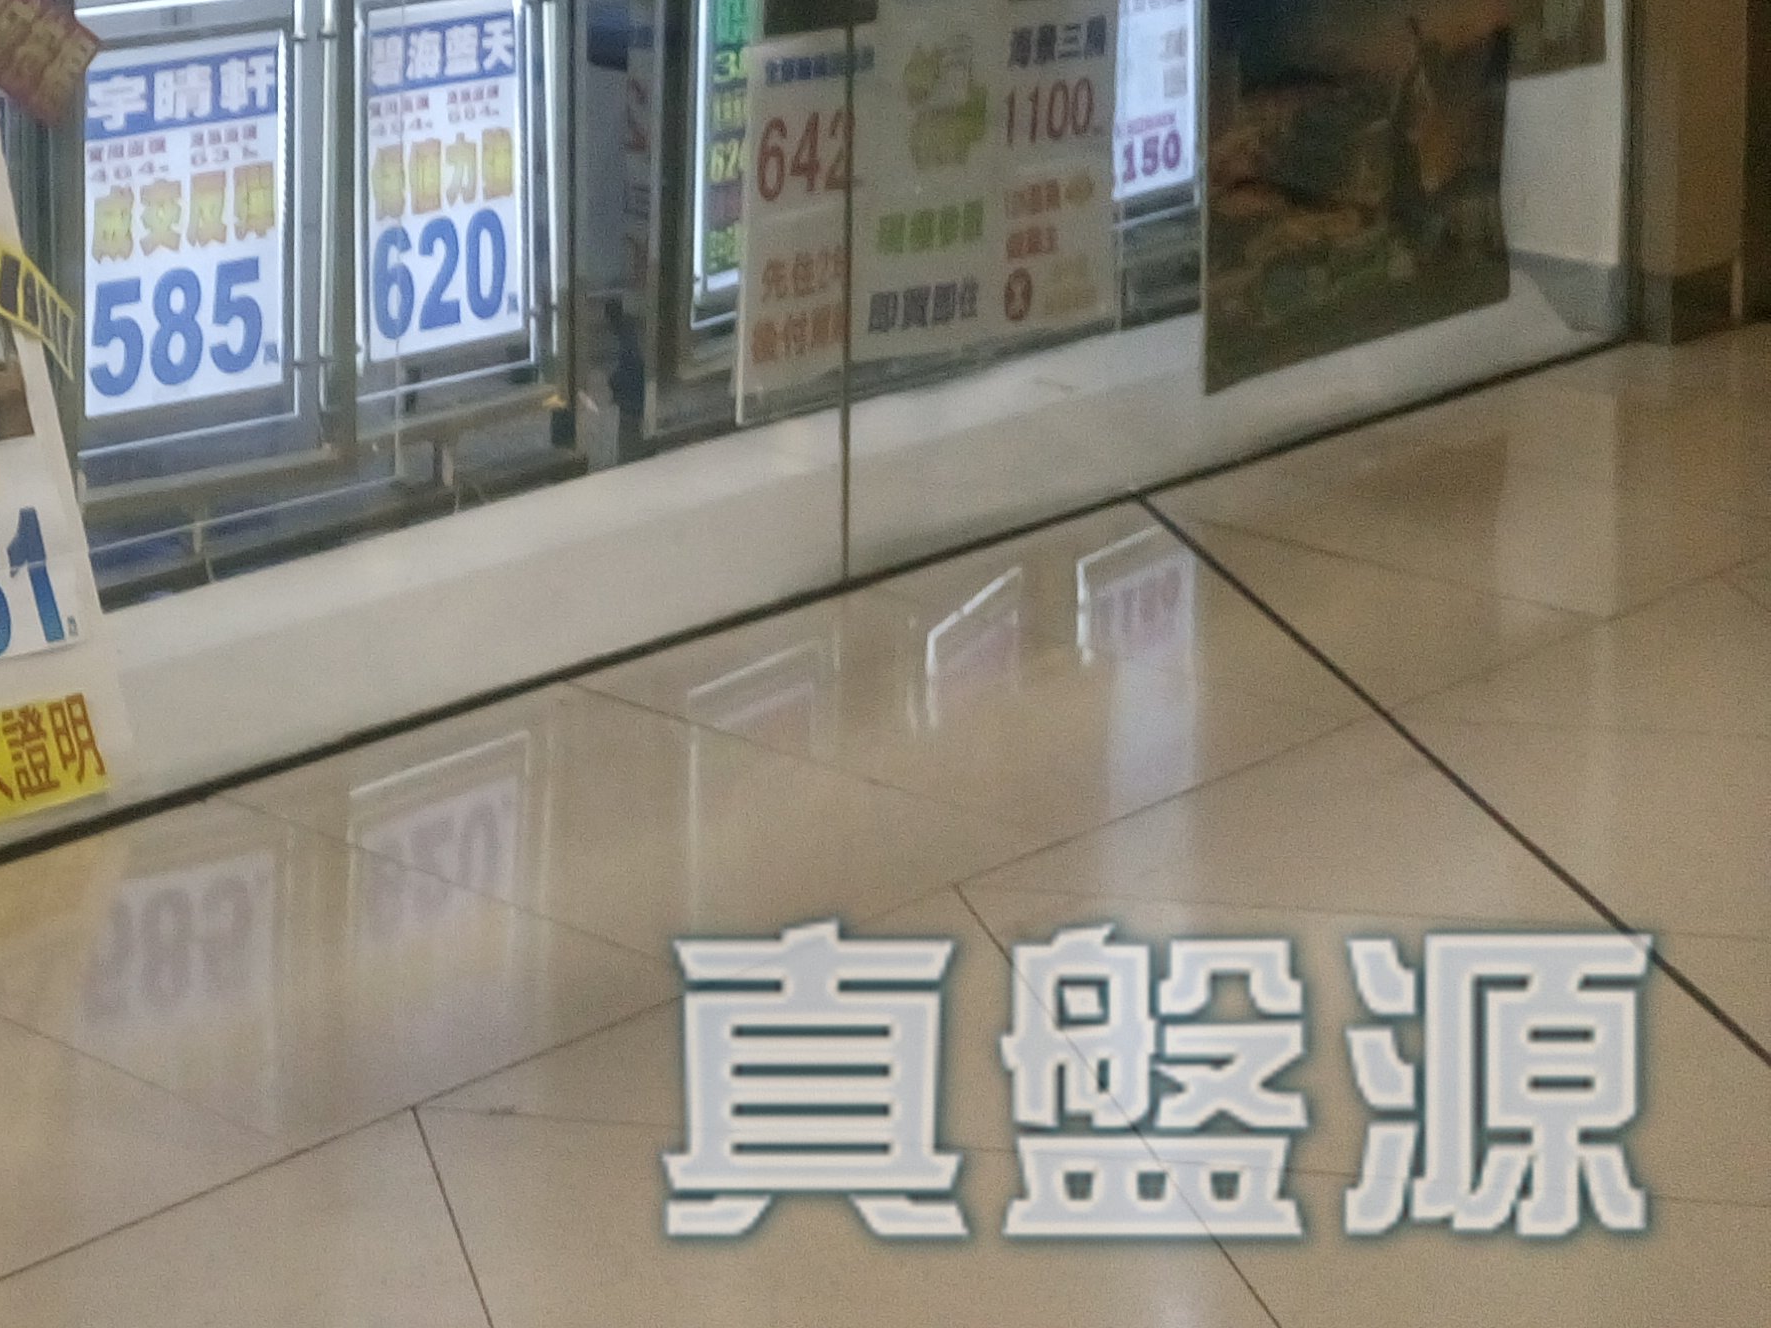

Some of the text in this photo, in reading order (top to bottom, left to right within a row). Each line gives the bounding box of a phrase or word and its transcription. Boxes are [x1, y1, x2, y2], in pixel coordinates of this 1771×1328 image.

[87, 56, 276, 132] 宇晴軒
[1005, 77, 1094, 151] 1100
